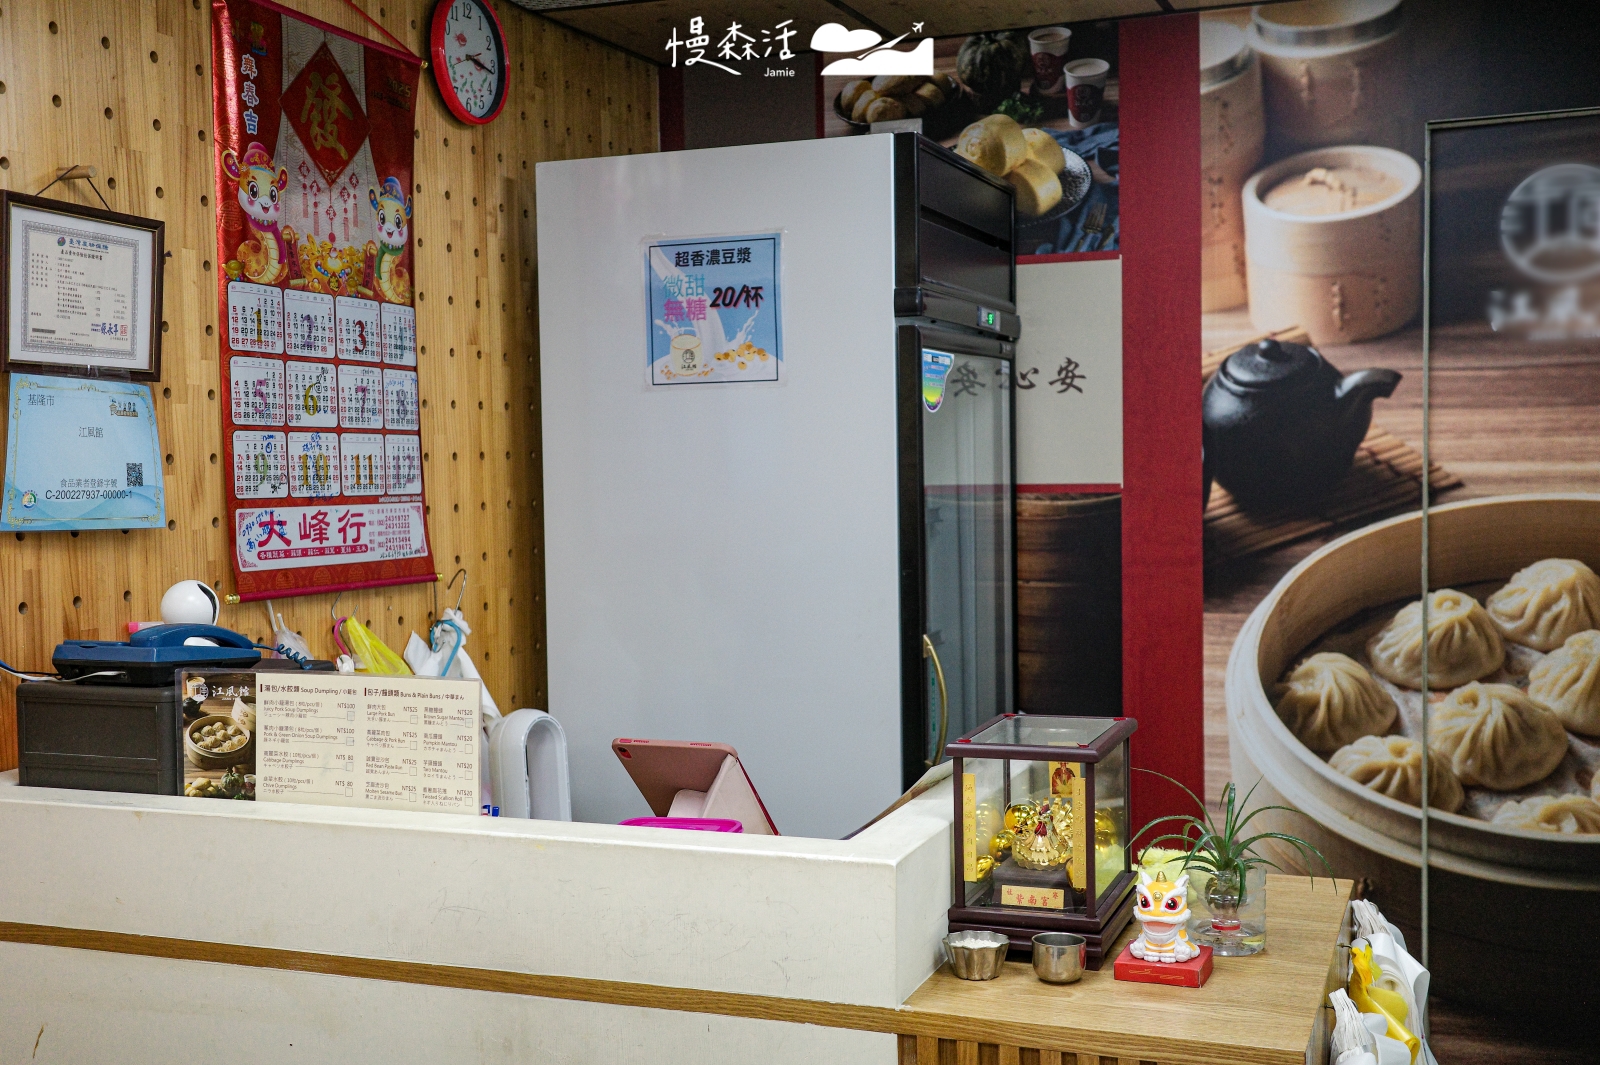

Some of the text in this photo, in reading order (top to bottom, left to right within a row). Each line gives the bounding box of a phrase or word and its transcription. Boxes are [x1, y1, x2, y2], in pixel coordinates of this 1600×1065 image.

[450, 5, 458, 21] 11
[462, 2, 472, 20] 12
[478, 16, 482, 31] 1
[486, 35, 492, 51] 2
[490, 60, 496, 75] 3
[241, 53, 259, 134] 舞春吉
[486, 81, 492, 96] 4
[466, 97, 472, 113] 6
[479, 94, 484, 110] 5
[675, 247, 752, 268] 超香濃豆漿
[663, 274, 706, 298] 微甜
[710, 284, 764, 310] 20/杯
[664, 297, 707, 322] 無糖
[354, 320, 366, 352] 3
[28, 394, 54, 406] 基隆市
[78, 426, 104, 438] 江風館
[353, 454, 375, 484] 11
[60, 478, 117, 488] 食品業者登錄字號
[45, 490, 132, 500] C-200227937-00000-1
[258, 509, 366, 548] 大峰行
